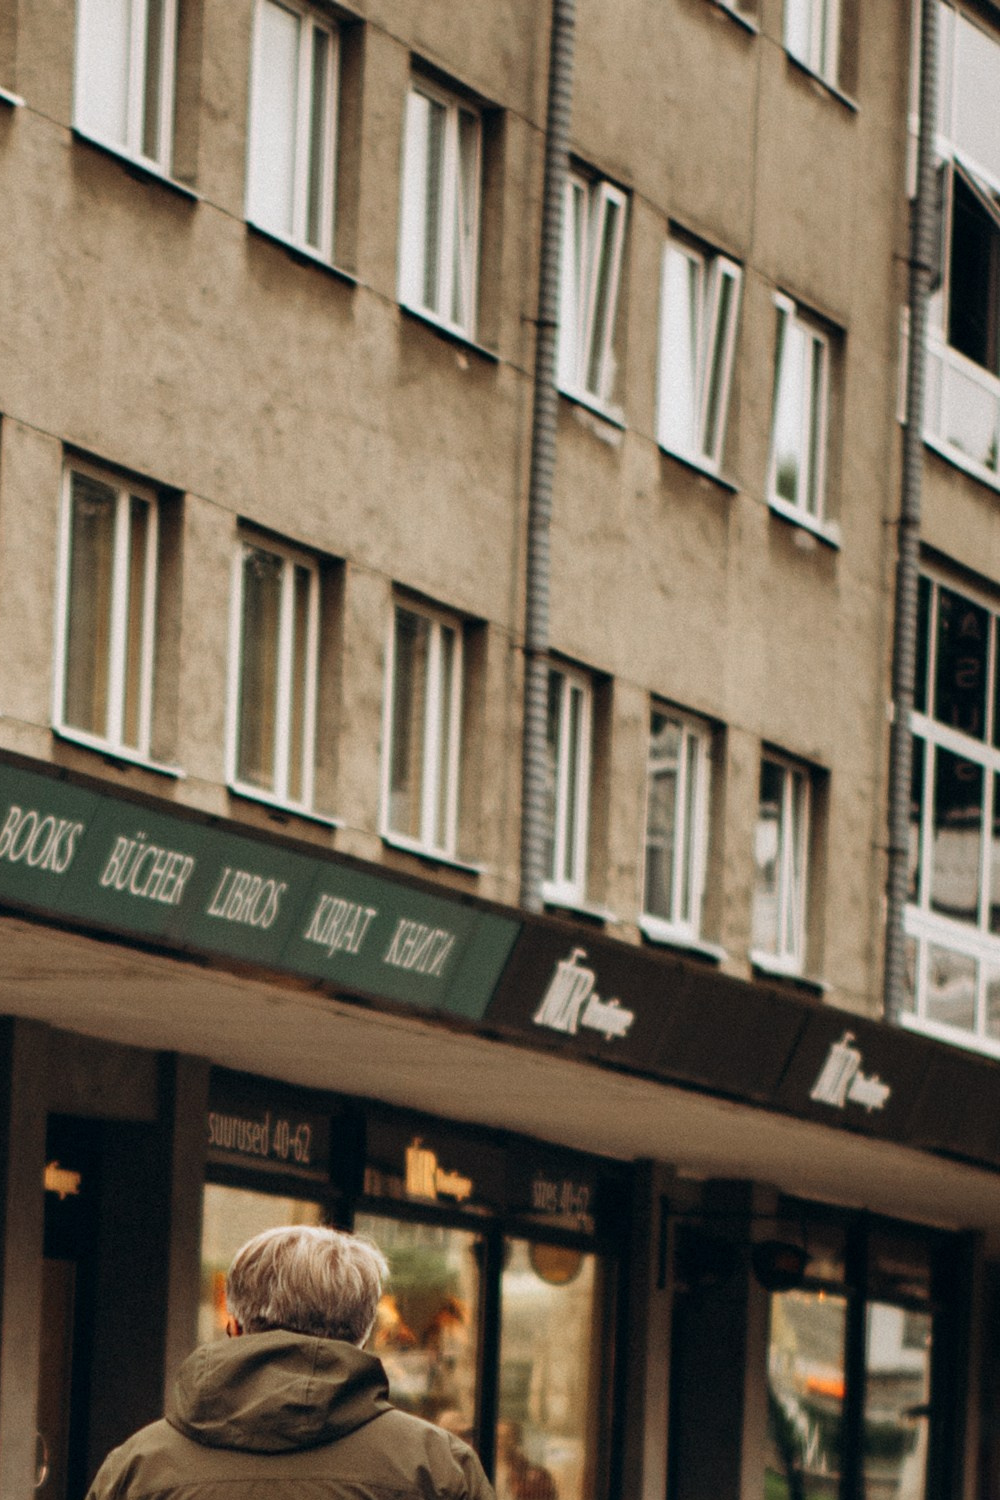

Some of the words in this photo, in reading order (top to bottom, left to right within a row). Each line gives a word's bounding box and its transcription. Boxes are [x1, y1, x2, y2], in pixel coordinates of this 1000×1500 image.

[99, 830, 196, 905] BÜCHER
[206, 867, 289, 930] LIBROS
[303, 893, 378, 958] KIRJAT
[382, 917, 456, 978] КНИГИ
